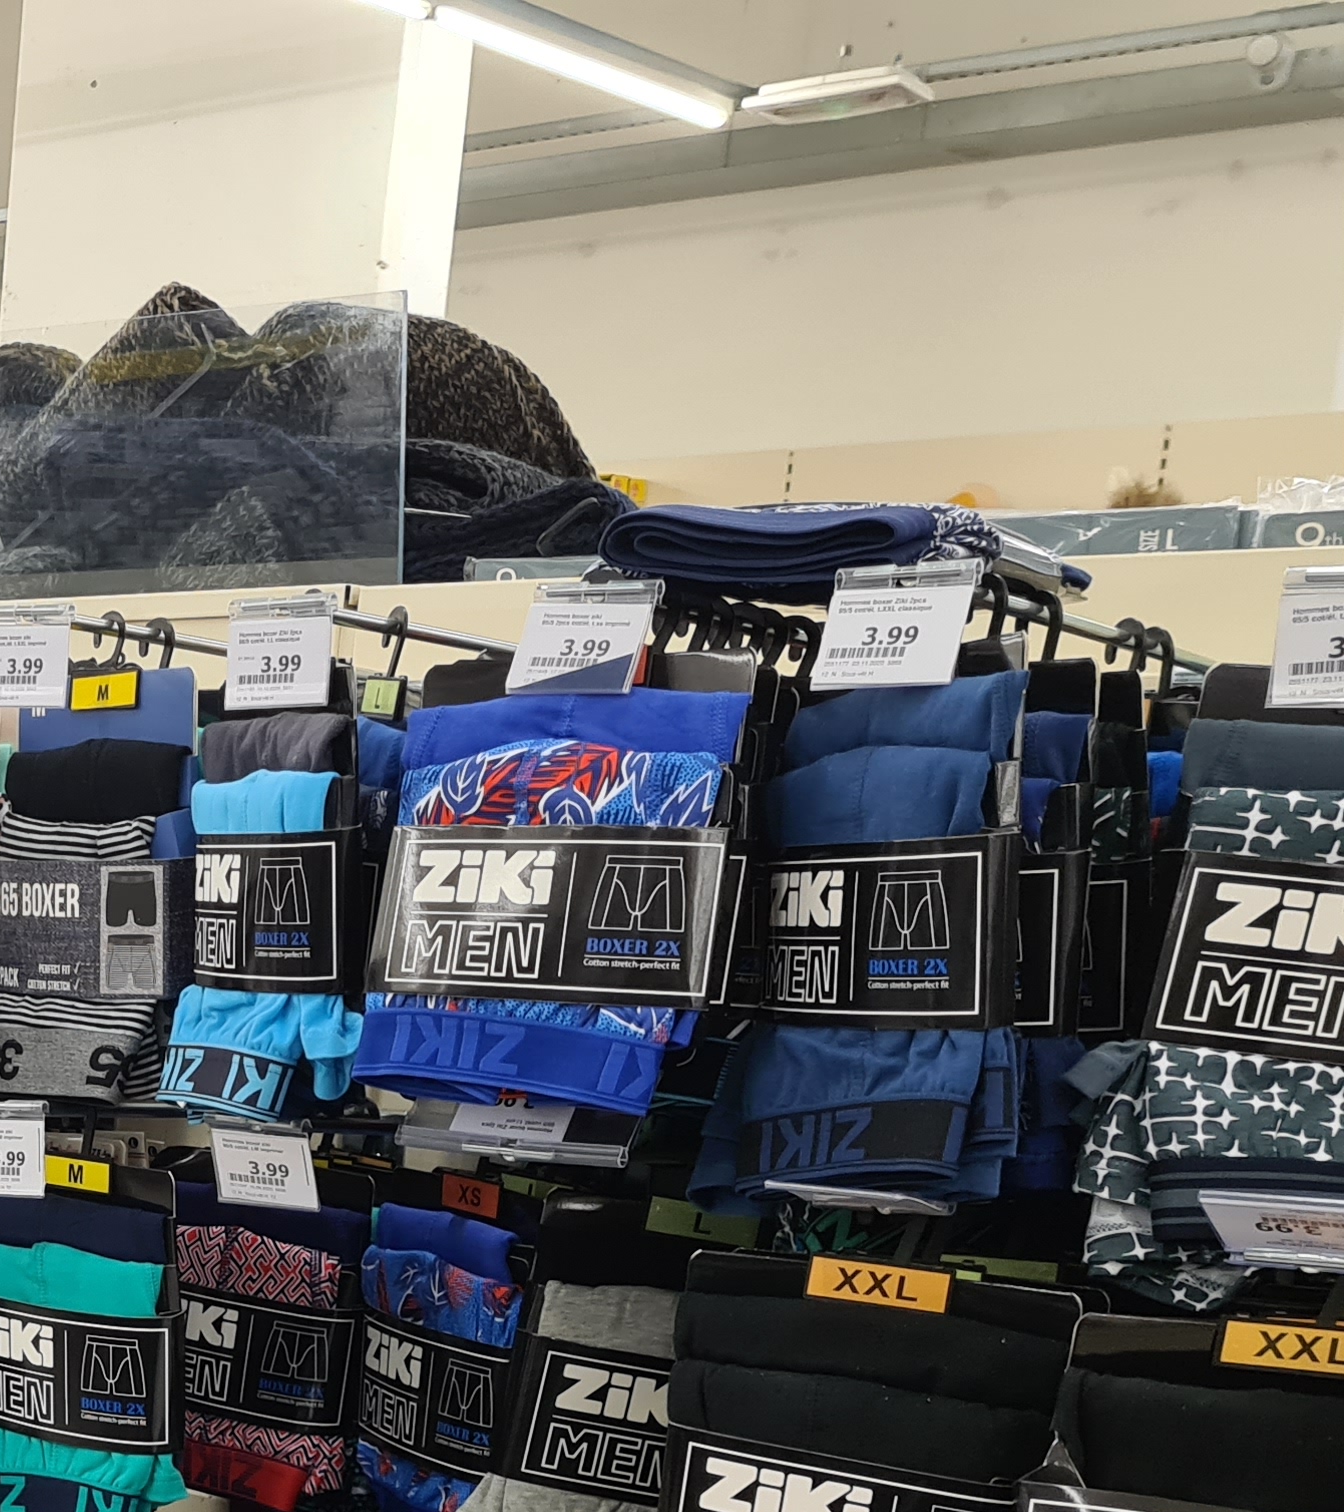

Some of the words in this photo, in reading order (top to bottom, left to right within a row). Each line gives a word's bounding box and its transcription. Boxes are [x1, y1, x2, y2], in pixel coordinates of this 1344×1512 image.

[1137, 528, 1160, 552] SIZE
[861, 625, 919, 647] 3.99
[559, 639, 611, 657] 3.99
[7, 657, 44, 674] 3.99
[260, 654, 301, 673] 3.99
[96, 684, 109, 702] M
[22, 881, 80, 919] BOXER
[401, 919, 544, 980] MEN
[585, 939, 649, 956] BOXER
[653, 939, 681, 956] 2X
[38, 963, 60, 975] PERFECT
[61, 964, 71, 975] FIT
[583, 956, 608, 968] Cotton
[610, 957, 668, 971] stretch-perfect
[671, 960, 680, 970] fit
[868, 958, 918, 976] BOXER
[923, 957, 949, 975] 2X
[764, 944, 840, 1005] MEN
[47, 980, 71, 991] STRETCH
[867, 980, 889, 990] Cotton
[889, 980, 939, 991] stretch-perfect
[940, 979, 949, 990] fit
[388, 1013, 524, 1077] ZIKI
[68, 1163, 84, 1185] M
[247, 1160, 290, 1178] 3.99
[458, 1184, 482, 1207] XS
[832, 1265, 918, 1303] XXL
[1252, 1329, 1344, 1365] XXL
[80, 1396, 122, 1413] BOXER
[126, 1402, 145, 1415] 2X
[80, 1412, 99, 1422] Cotton
